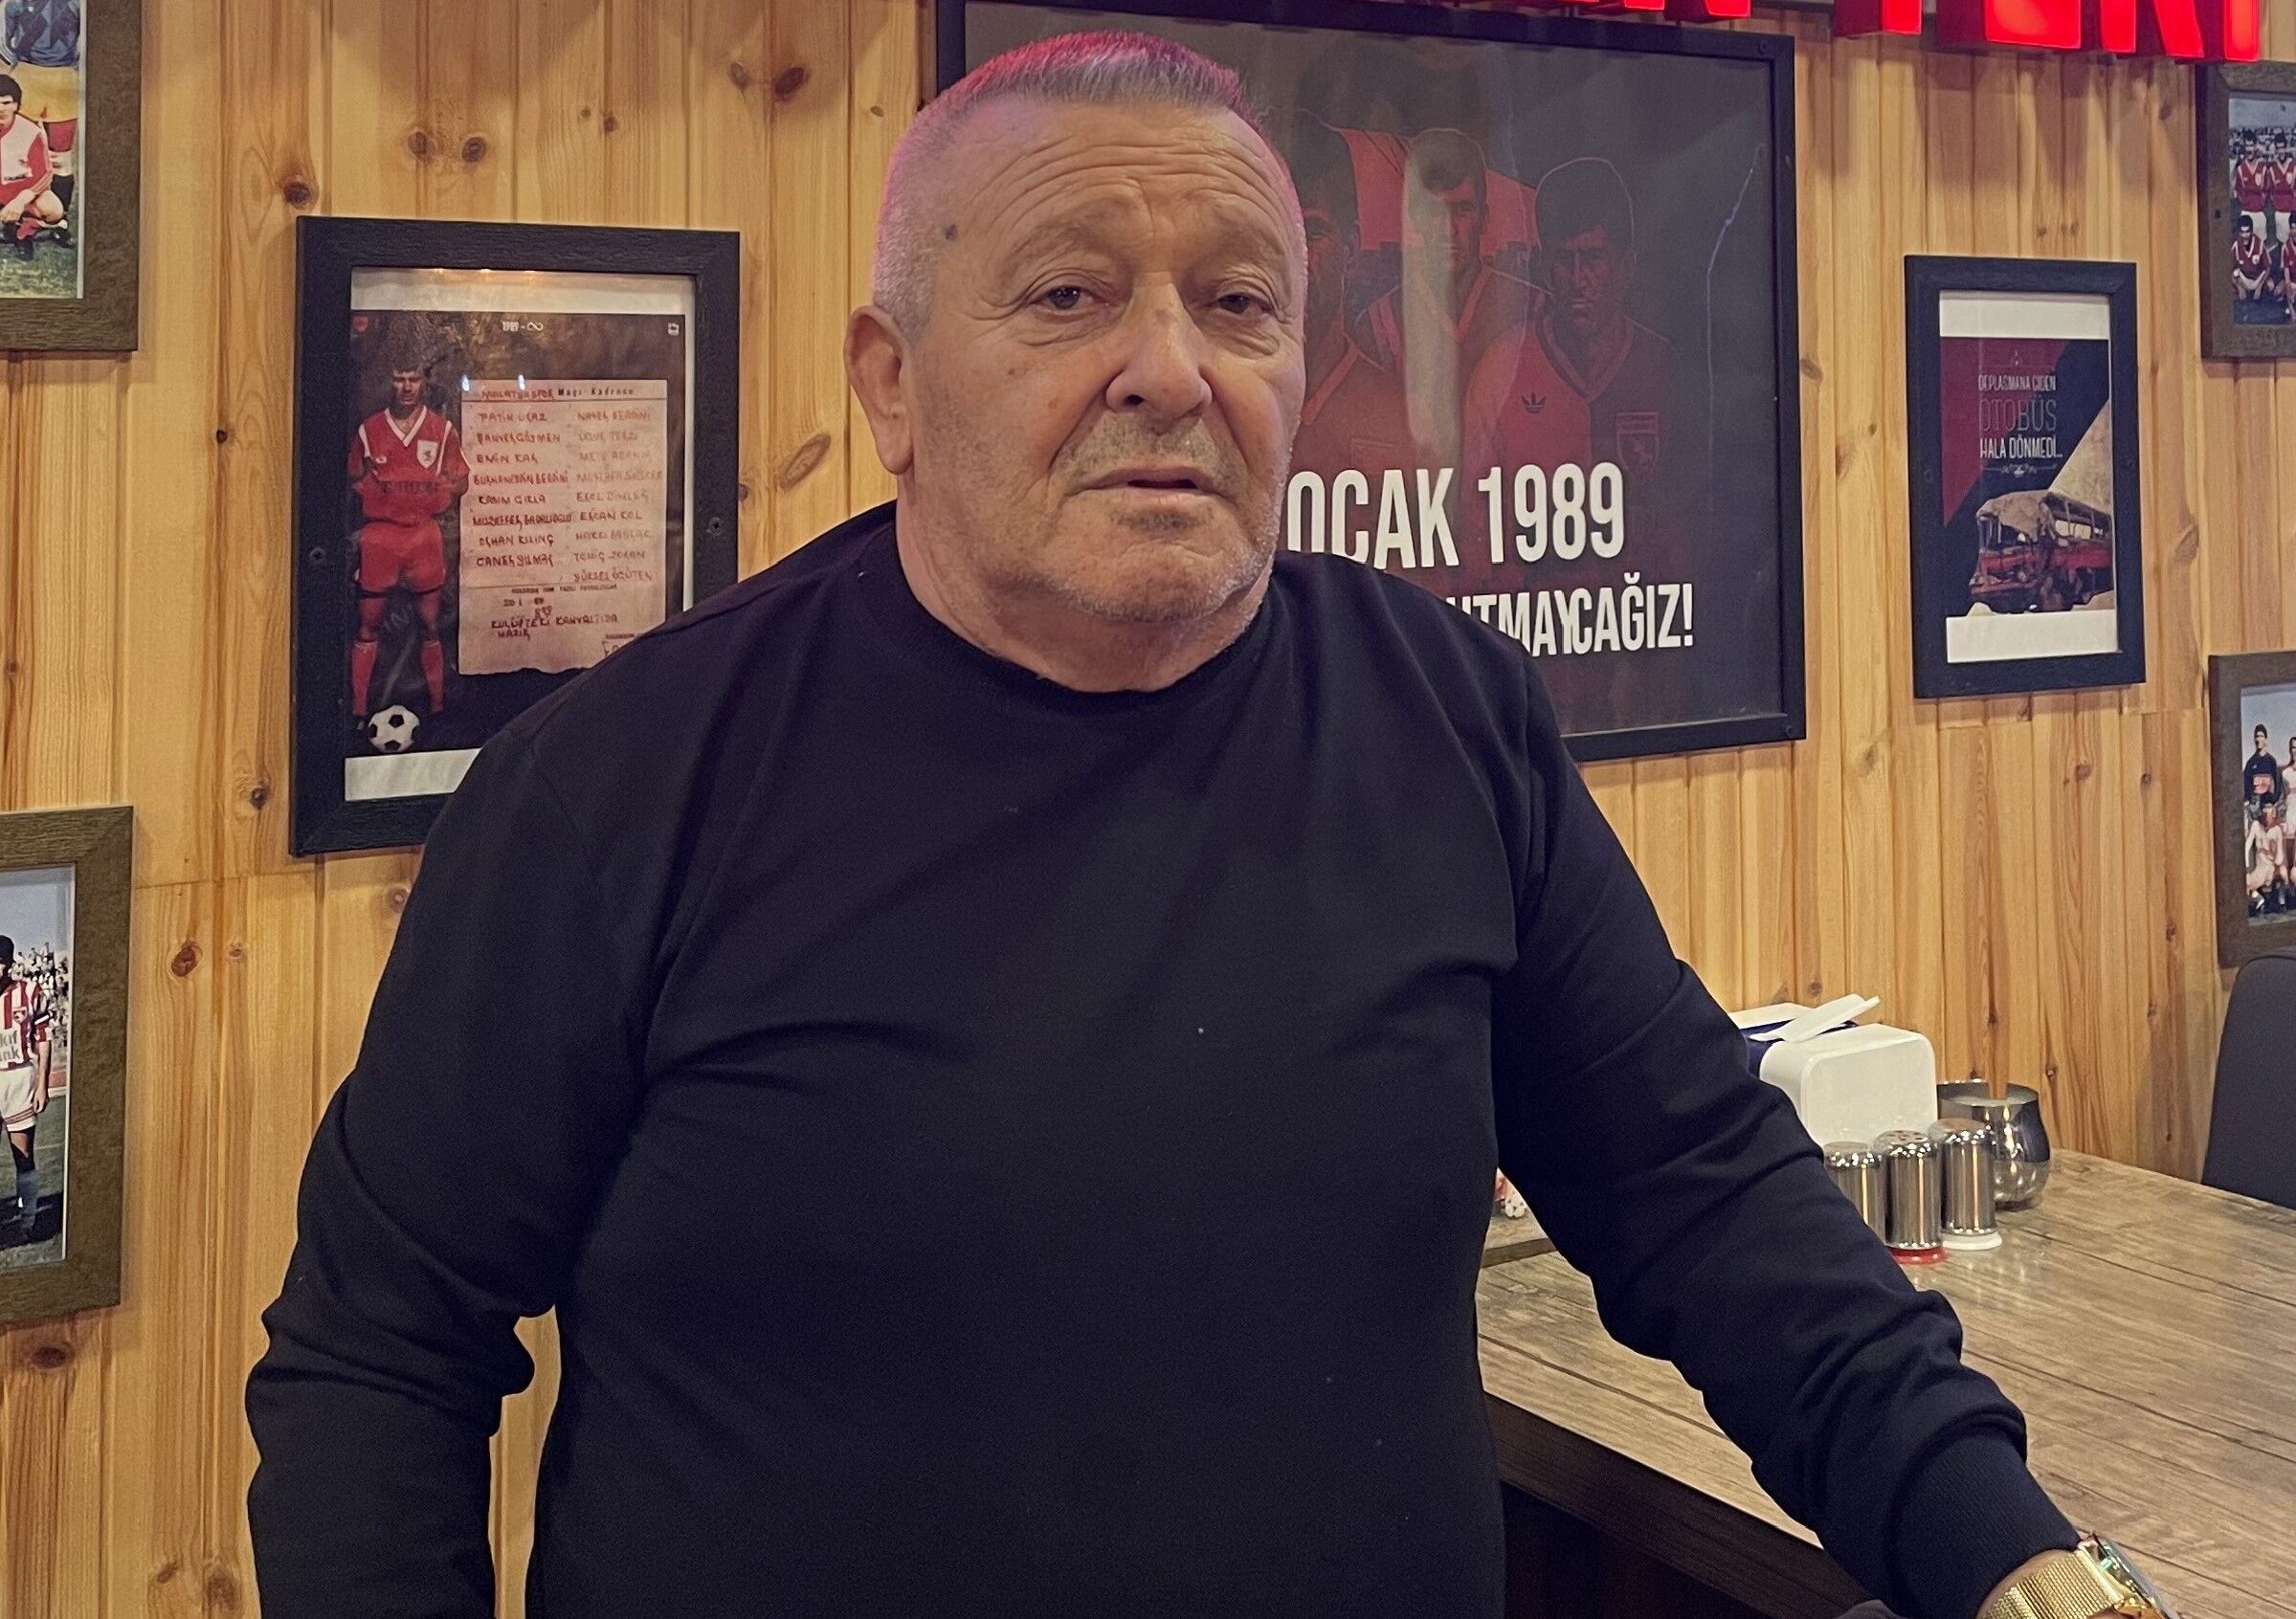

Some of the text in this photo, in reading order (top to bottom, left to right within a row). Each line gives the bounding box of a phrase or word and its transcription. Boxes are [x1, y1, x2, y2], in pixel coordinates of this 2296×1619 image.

[1978, 394, 2057, 432] OTOBÜS
[1980, 437, 2006, 459] HALA
[1287, 461, 1624, 569] OCAK 1989
